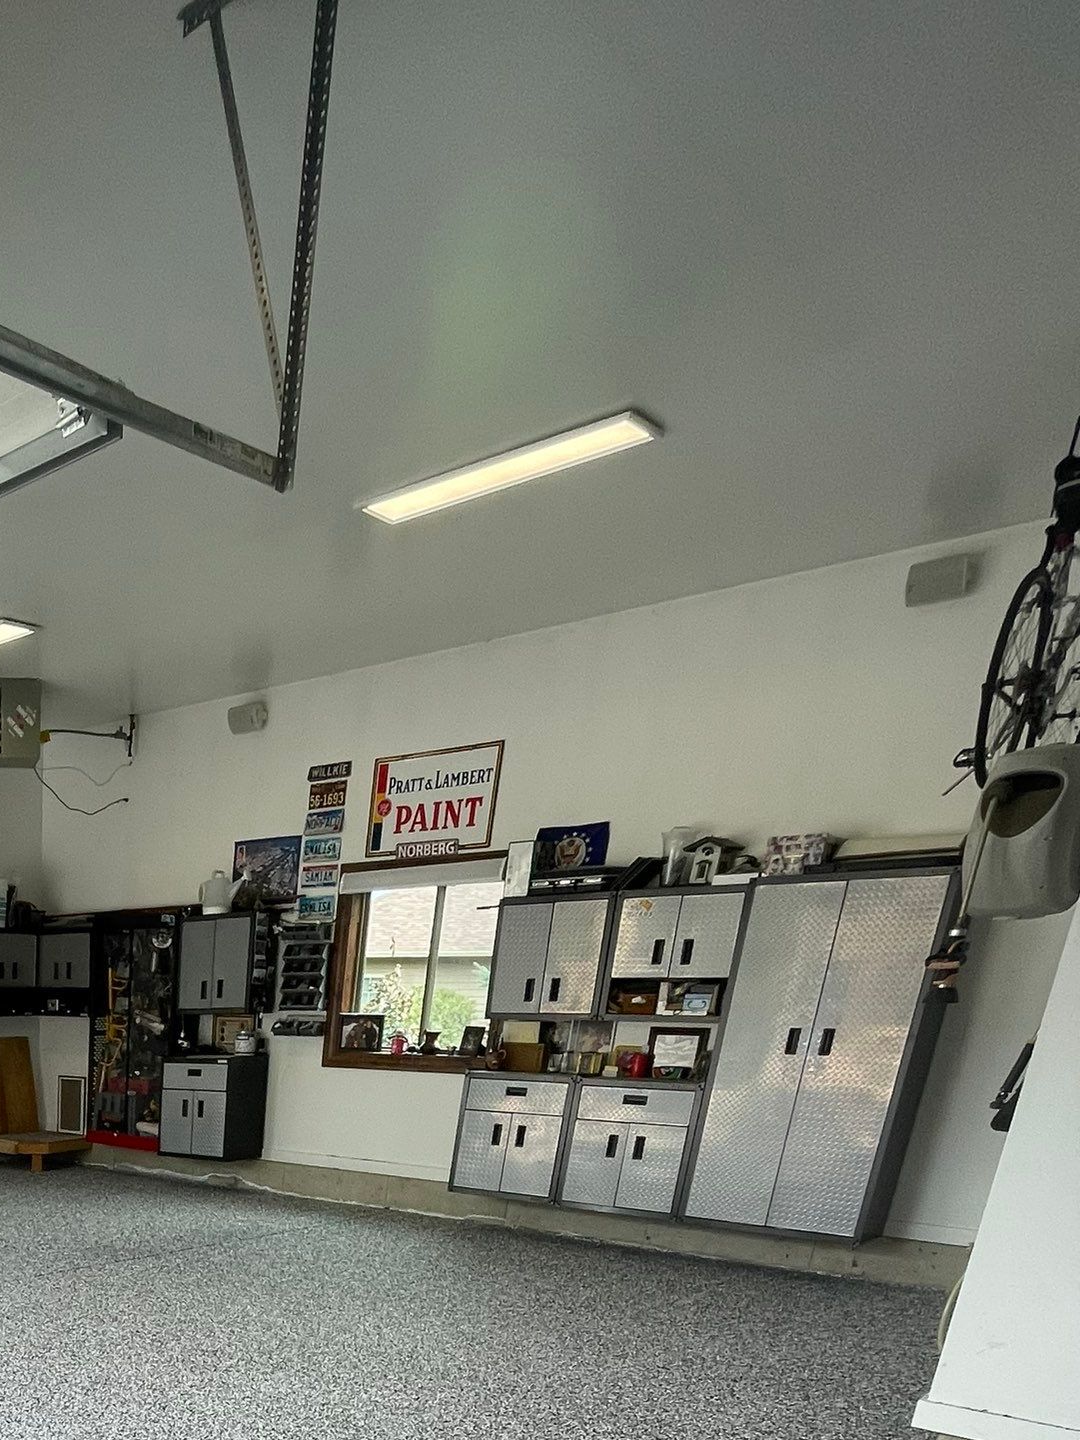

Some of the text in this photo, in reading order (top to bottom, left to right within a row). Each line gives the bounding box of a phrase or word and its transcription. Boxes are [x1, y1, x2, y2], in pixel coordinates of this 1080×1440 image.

[311, 764, 348, 777] WILLKIE
[388, 768, 494, 795] PRATT & LAMBERT
[393, 796, 484, 834] PAINT
[397, 841, 456, 859] NORBERG
